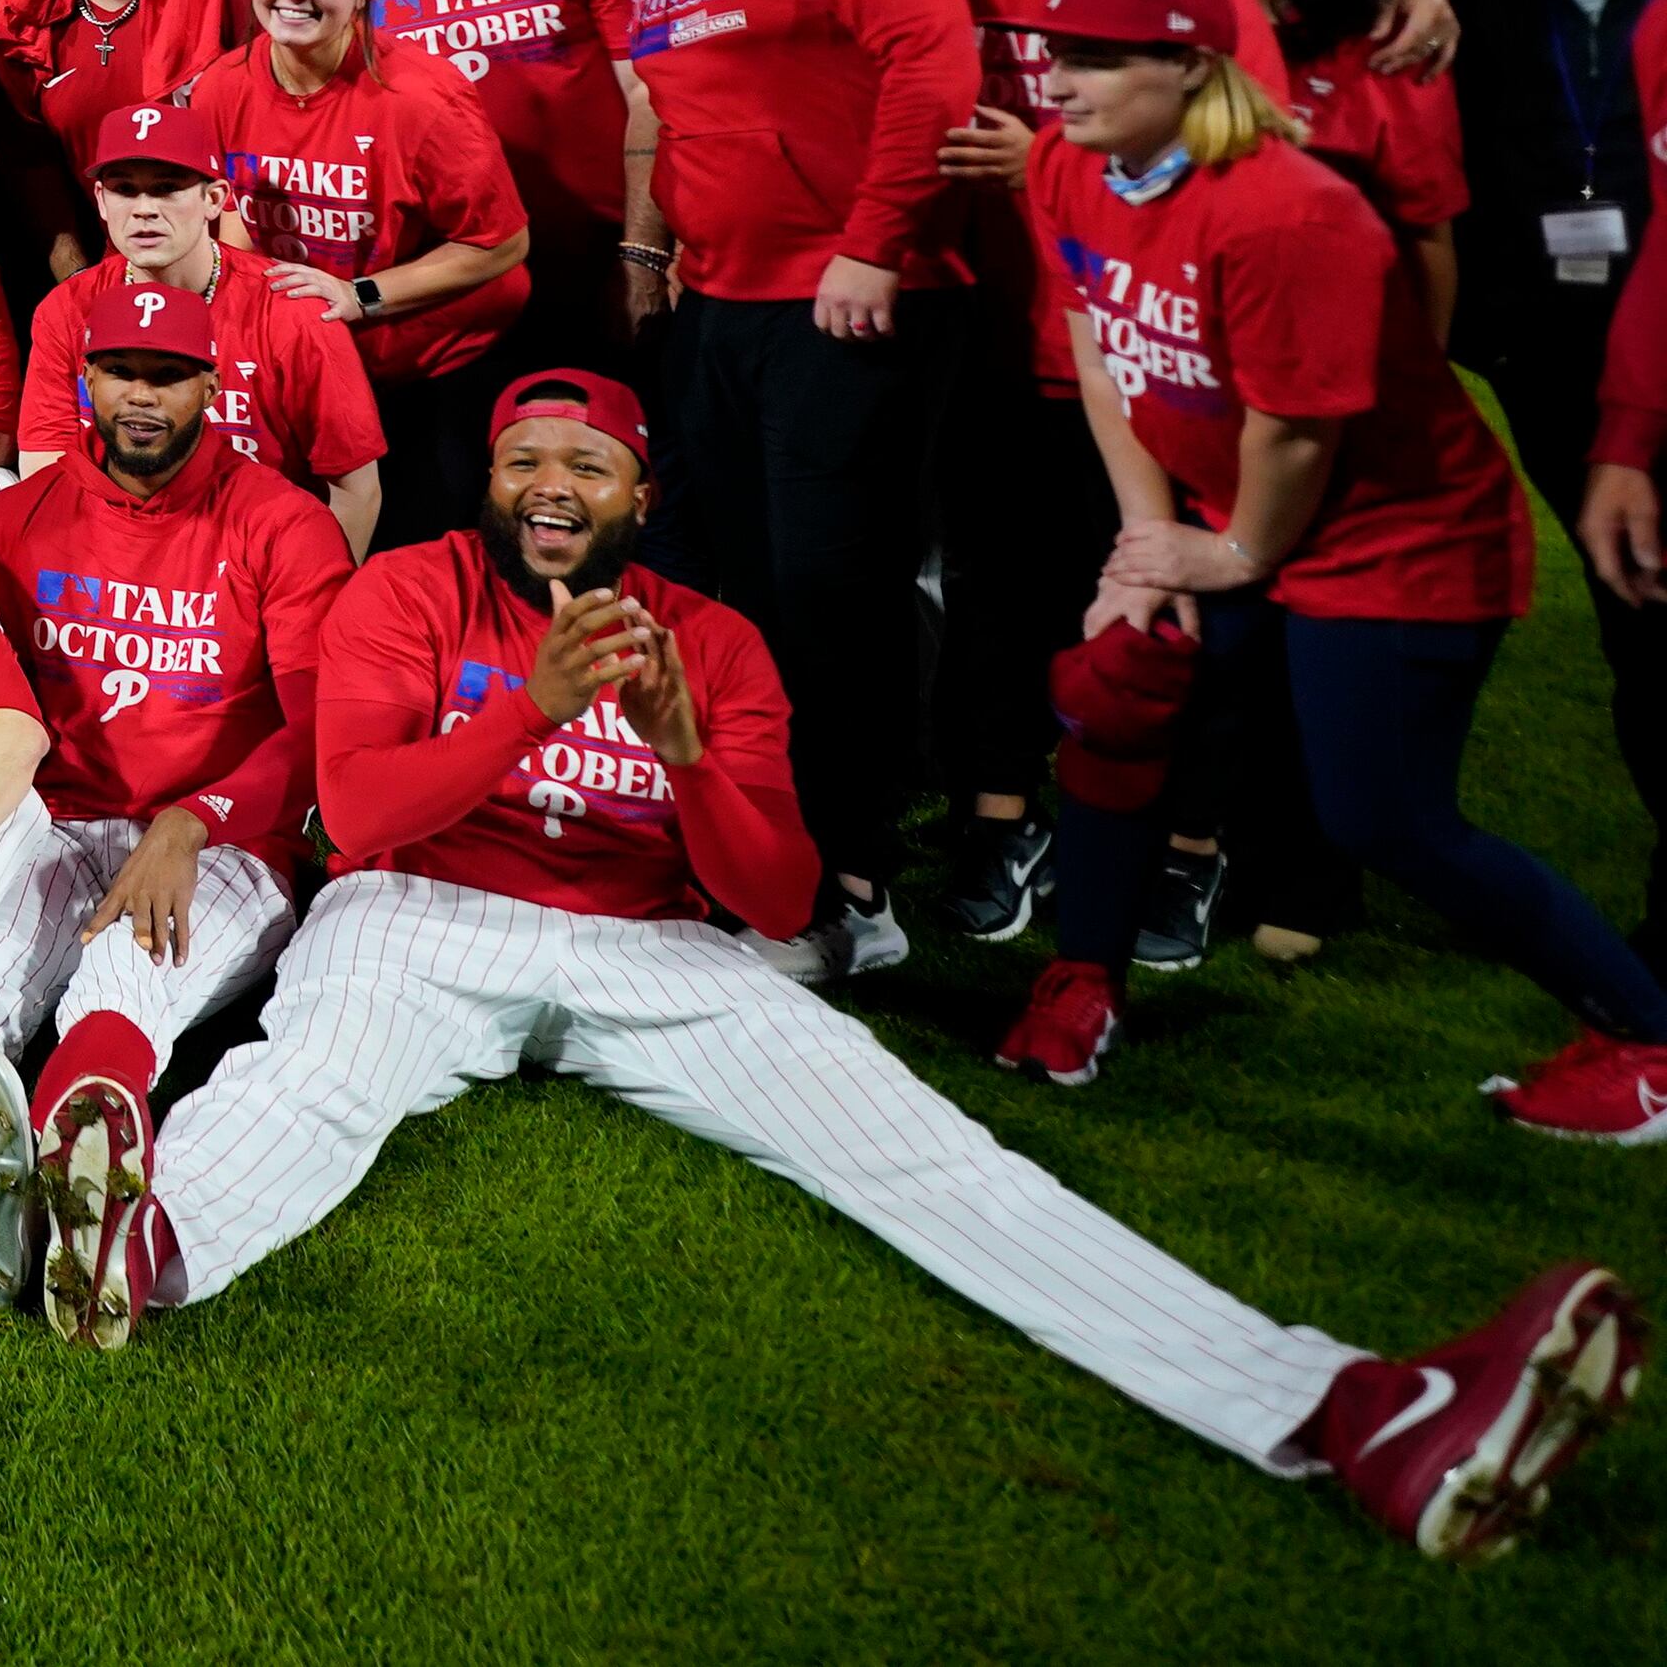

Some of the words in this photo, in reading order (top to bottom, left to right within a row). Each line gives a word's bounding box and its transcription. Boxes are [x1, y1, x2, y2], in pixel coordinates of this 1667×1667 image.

[261, 156, 366, 199] TAKE
[233, 193, 377, 241] CTOBER
[133, 291, 165, 328] P
[108, 581, 217, 627] TAKE
[43, 618, 222, 674] OCTOBER
[101, 670, 149, 722] P
[530, 780, 585, 837] P
